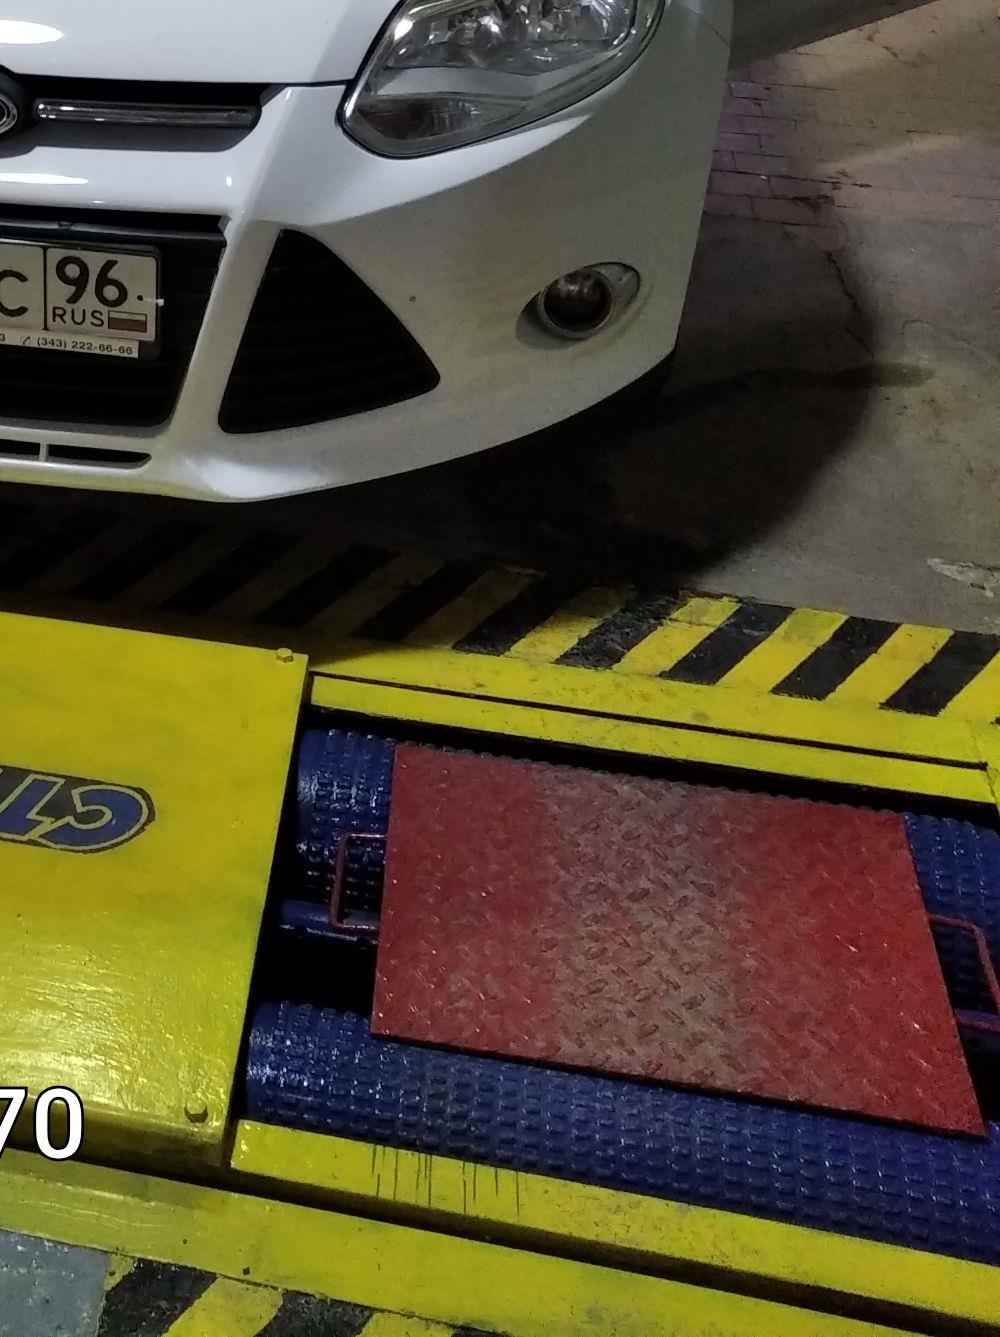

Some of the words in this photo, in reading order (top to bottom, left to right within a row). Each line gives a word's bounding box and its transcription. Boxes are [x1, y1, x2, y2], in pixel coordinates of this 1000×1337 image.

[55, 255, 128, 307] 96
[52, 306, 105, 328] RUS
[0, 333, 6, 342] 3
[37, 337, 67, 349] (343)
[71, 340, 134, 356] 222-66-66
